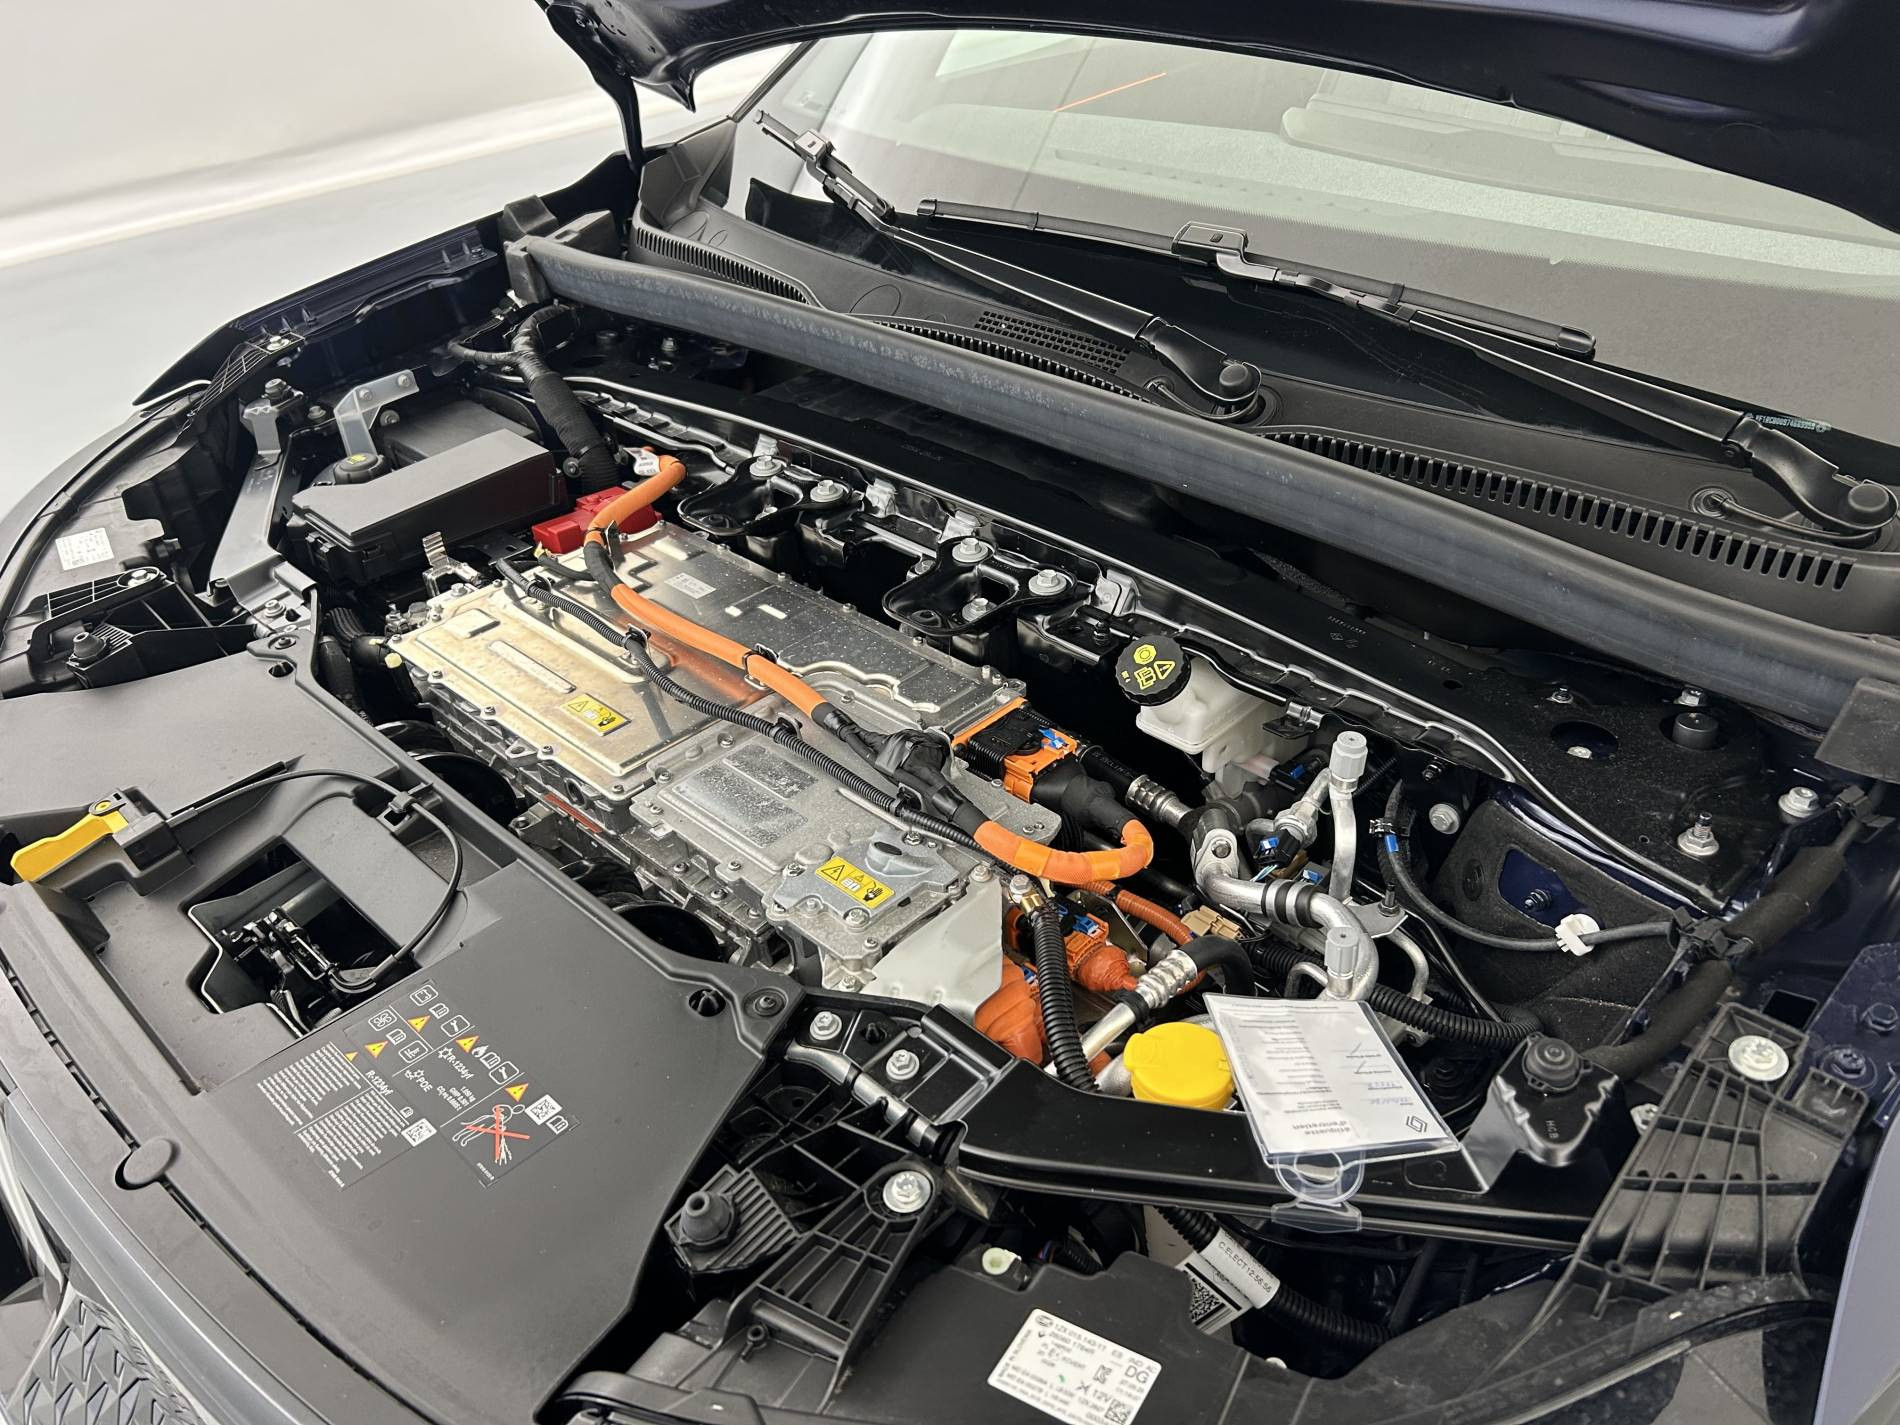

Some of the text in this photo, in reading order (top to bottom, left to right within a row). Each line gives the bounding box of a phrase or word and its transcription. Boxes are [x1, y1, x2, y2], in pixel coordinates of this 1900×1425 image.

[446, 1056, 474, 1080] R-1234yf
[365, 1070, 393, 1096] R-1234yf
[416, 1077, 433, 1093] POE
[1124, 1364, 1150, 1384] DG
